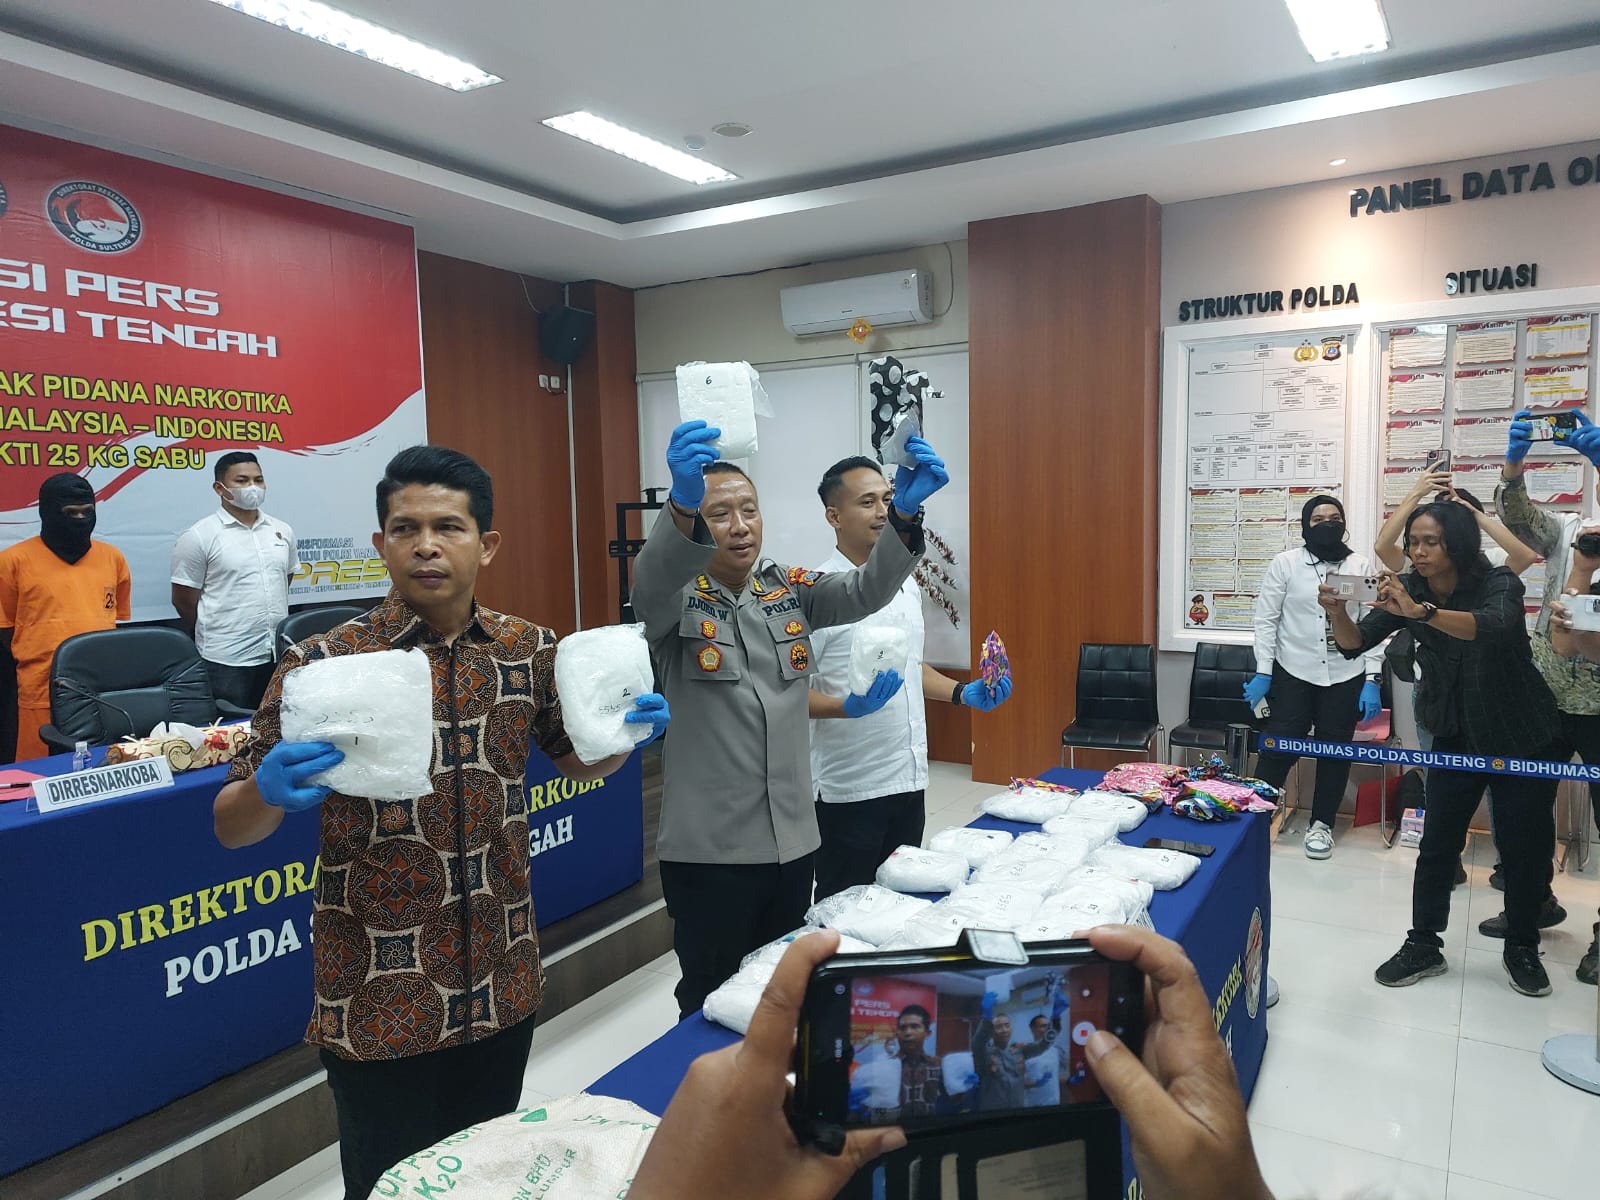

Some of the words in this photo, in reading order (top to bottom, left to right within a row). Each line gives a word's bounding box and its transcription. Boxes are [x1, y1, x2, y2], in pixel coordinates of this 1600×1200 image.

[1350, 178, 1452, 217] PANEL
[1463, 162, 1555, 200] DATA
[69, 233, 97, 250] POLDA
[98, 239, 132, 252] SULTENG
[65, 268, 219, 316] PERS
[1445, 263, 1537, 295] SITUASI
[1179, 290, 1284, 321] STRUKTUR
[1290, 282, 1360, 310] POLDA
[0, 301, 66, 334] SI
[76, 310, 277, 358] TENGAH
[42, 374, 150, 405] PIDANA
[154, 384, 292, 415] NARKOTIKA
[705, 375, 713, 385] 6
[0, 406, 129, 436] ALAYSIA
[155, 416, 284, 443] INDONESIA
[47, 443, 80, 467] 25
[87, 444, 129, 469] KG
[135, 446, 205, 470] SABU
[293, 559, 392, 586] PRES
[622, 687, 632, 698] 2
[1279, 739, 1354, 757] BIDHUMAS
[1358, 748, 1409, 763] POLDA
[1412, 752, 1486, 769] SULTENG
[1510, 760, 1600, 779] BIDHUMAS
[48, 763, 159, 803] DIRRESNARKOBA
[164, 919, 302, 998] POLDA
